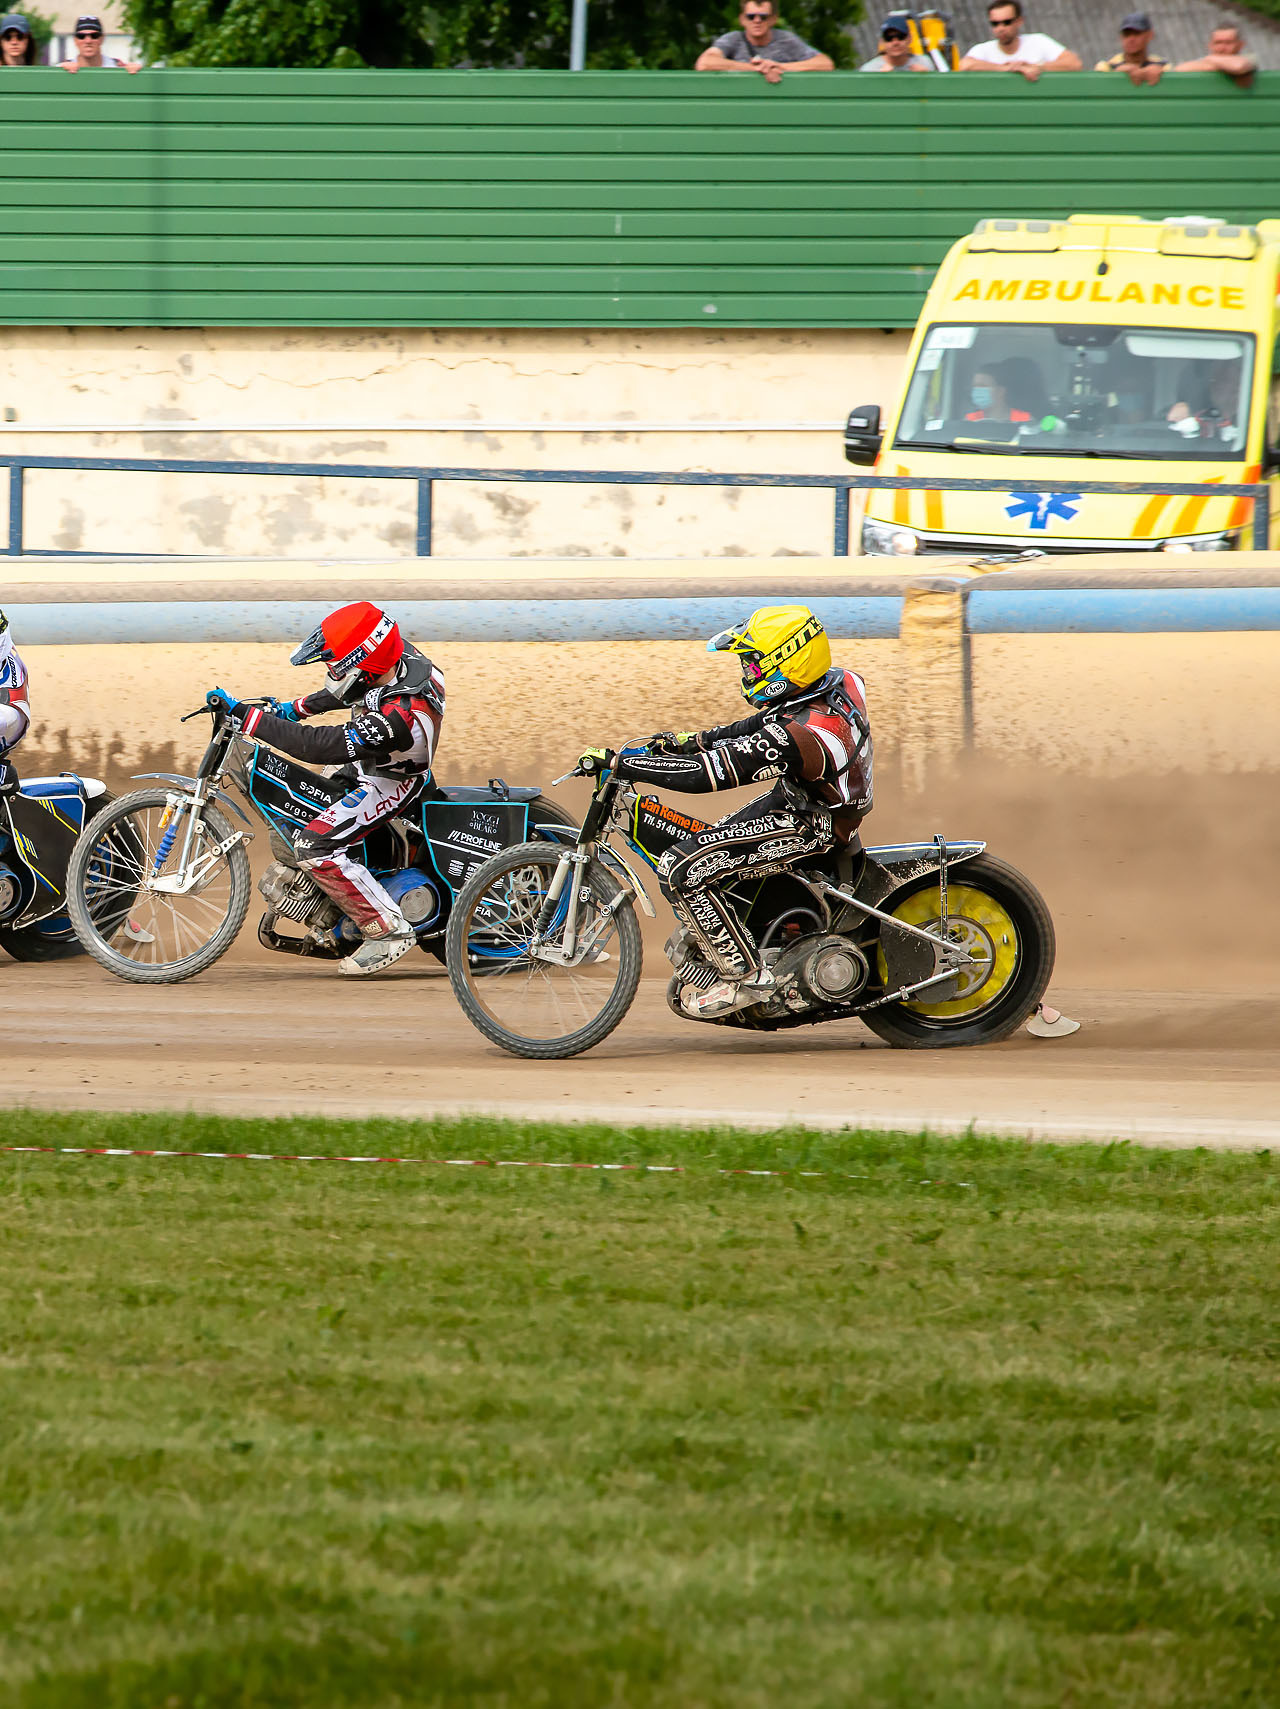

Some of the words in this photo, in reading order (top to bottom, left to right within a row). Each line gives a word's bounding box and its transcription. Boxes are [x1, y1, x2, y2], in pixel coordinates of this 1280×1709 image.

[952, 278, 1247, 310] AMBULANCE
[363, 778, 414, 822] LATVIA
[640, 797, 660, 815] Jan
[660, 804, 691, 829] Reime
[655, 819, 666, 831] 51
[665, 824, 676, 836] 48
[697, 821, 776, 845] NØRGAARD
